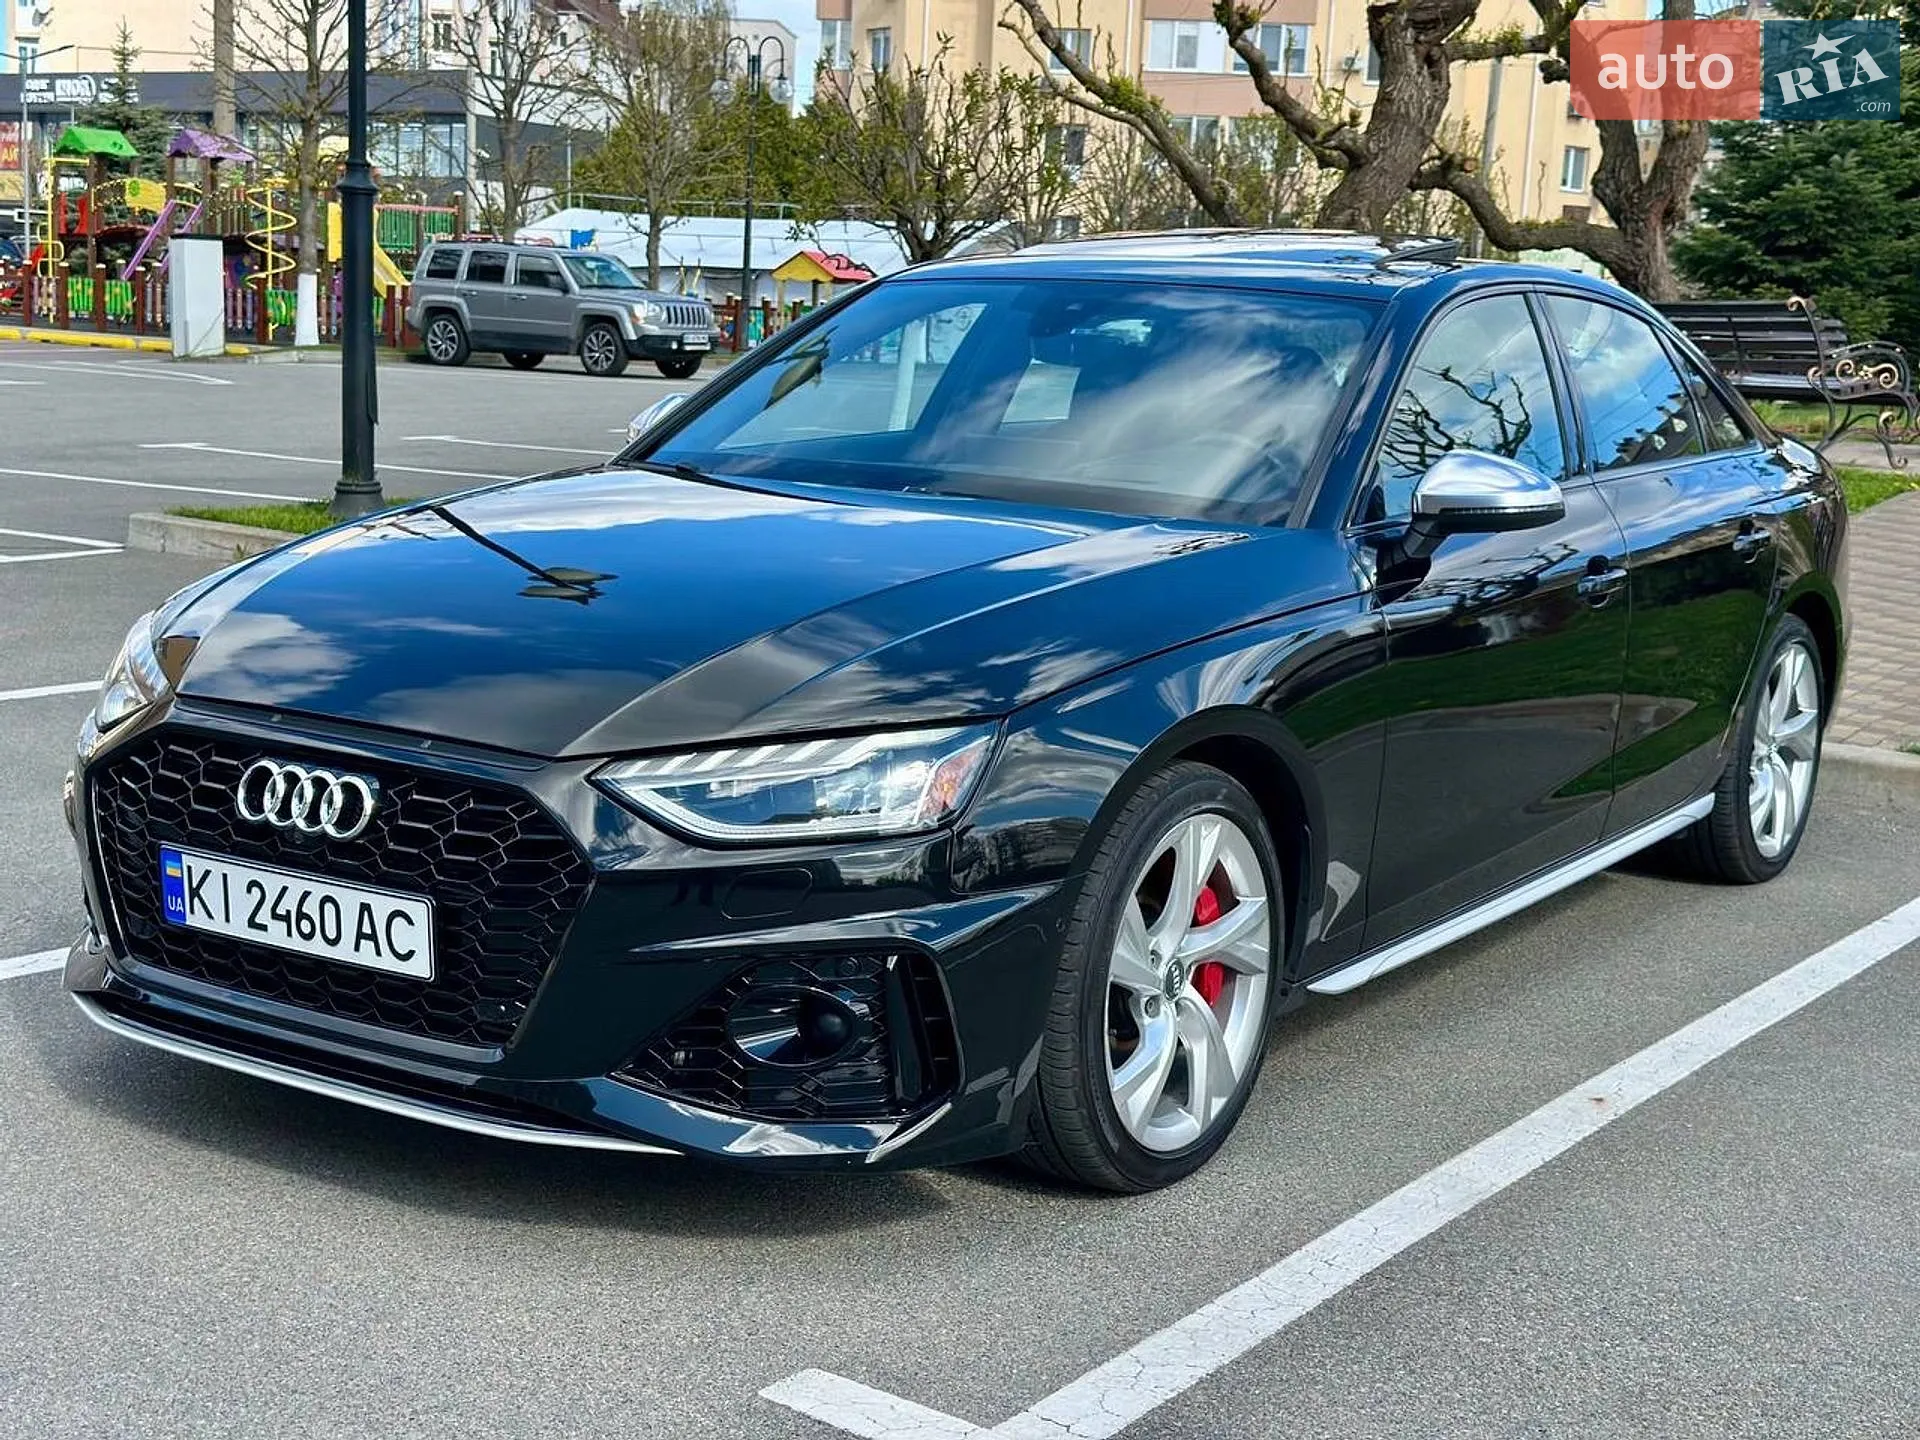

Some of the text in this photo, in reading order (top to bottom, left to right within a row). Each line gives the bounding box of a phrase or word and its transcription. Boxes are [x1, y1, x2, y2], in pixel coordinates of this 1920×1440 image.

[167, 895, 184, 913] UA
[187, 864, 416, 962] KI 2460 AC
